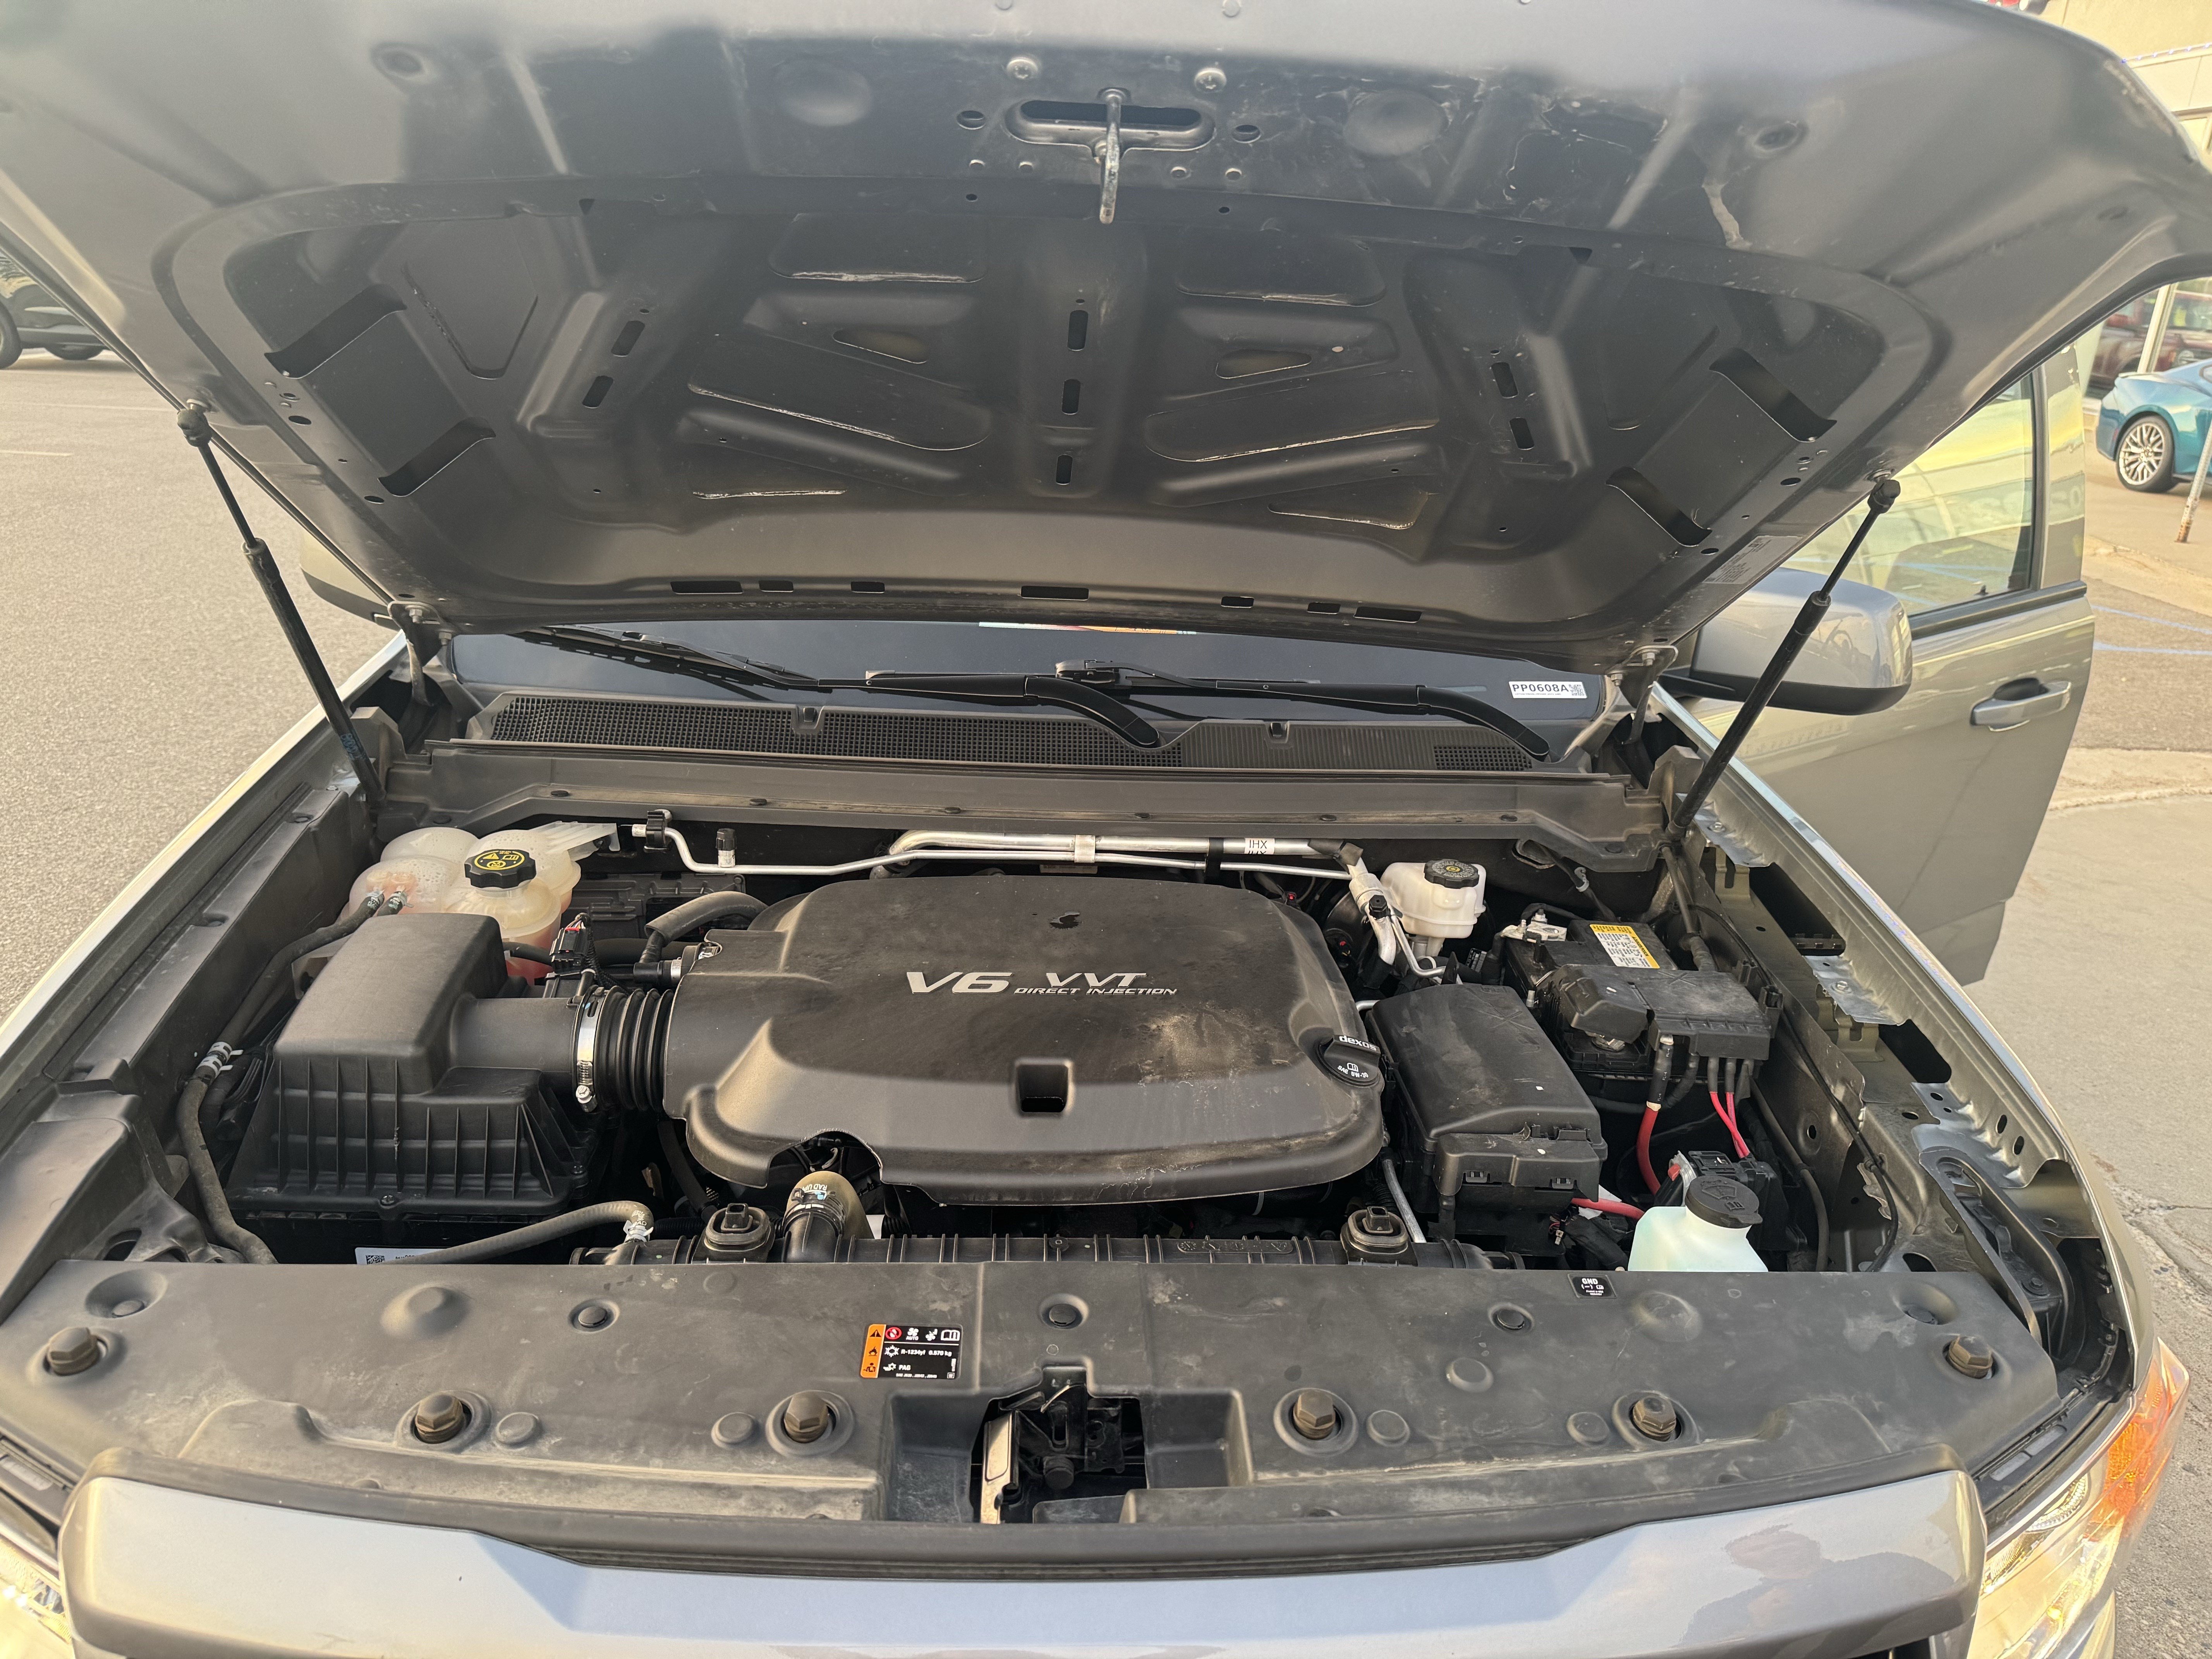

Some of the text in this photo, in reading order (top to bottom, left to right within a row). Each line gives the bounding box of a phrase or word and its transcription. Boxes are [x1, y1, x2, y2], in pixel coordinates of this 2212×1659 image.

[1249, 840, 1267, 848] IHX
[907, 972, 1147, 994] V6 VVT
[1339, 1035, 1377, 1051] dexos
[1337, 1065, 1349, 1074] SAE
